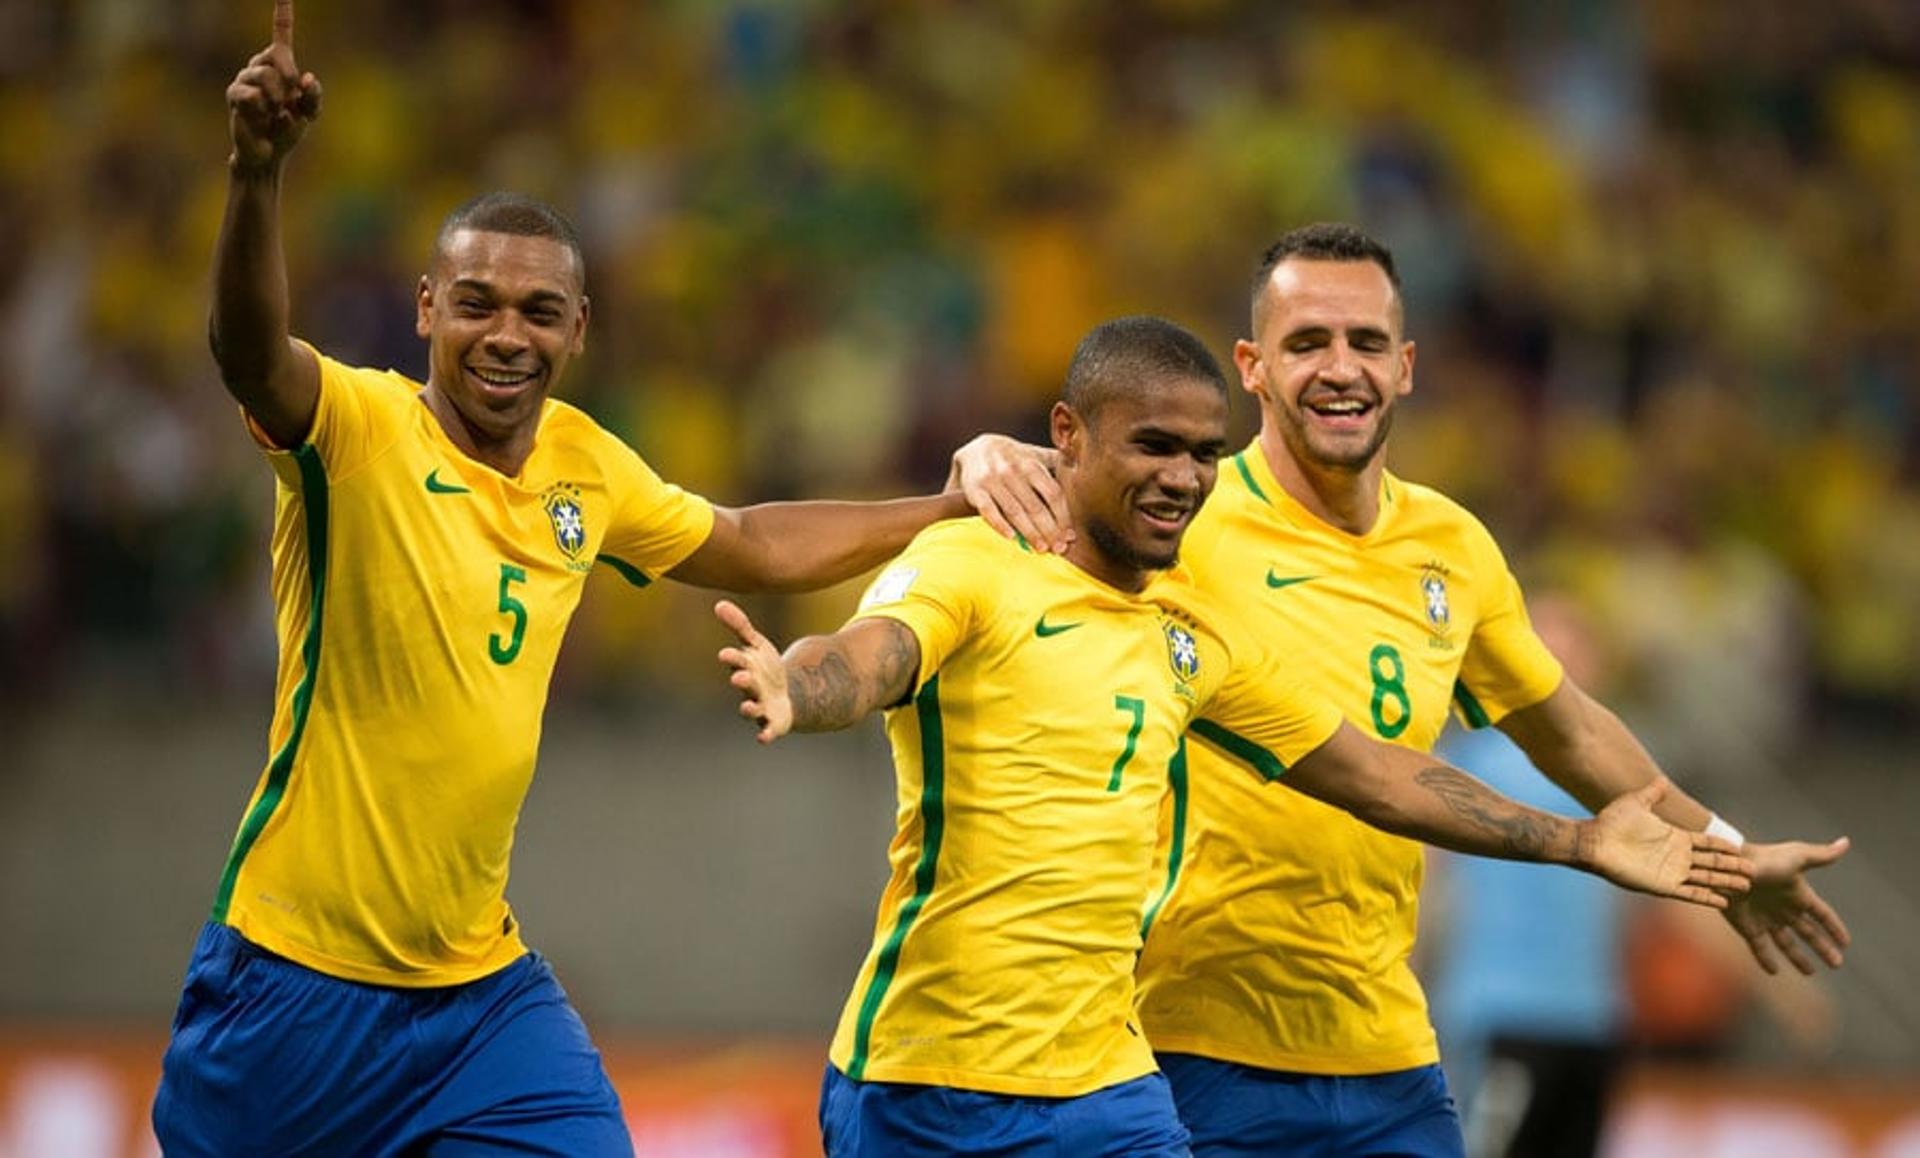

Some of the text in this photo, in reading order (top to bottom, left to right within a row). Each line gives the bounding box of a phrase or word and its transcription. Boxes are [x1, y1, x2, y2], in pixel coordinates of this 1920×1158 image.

[489, 564, 527, 665] 5
[1369, 643, 1410, 739] 8
[1107, 696, 1144, 792] 7
